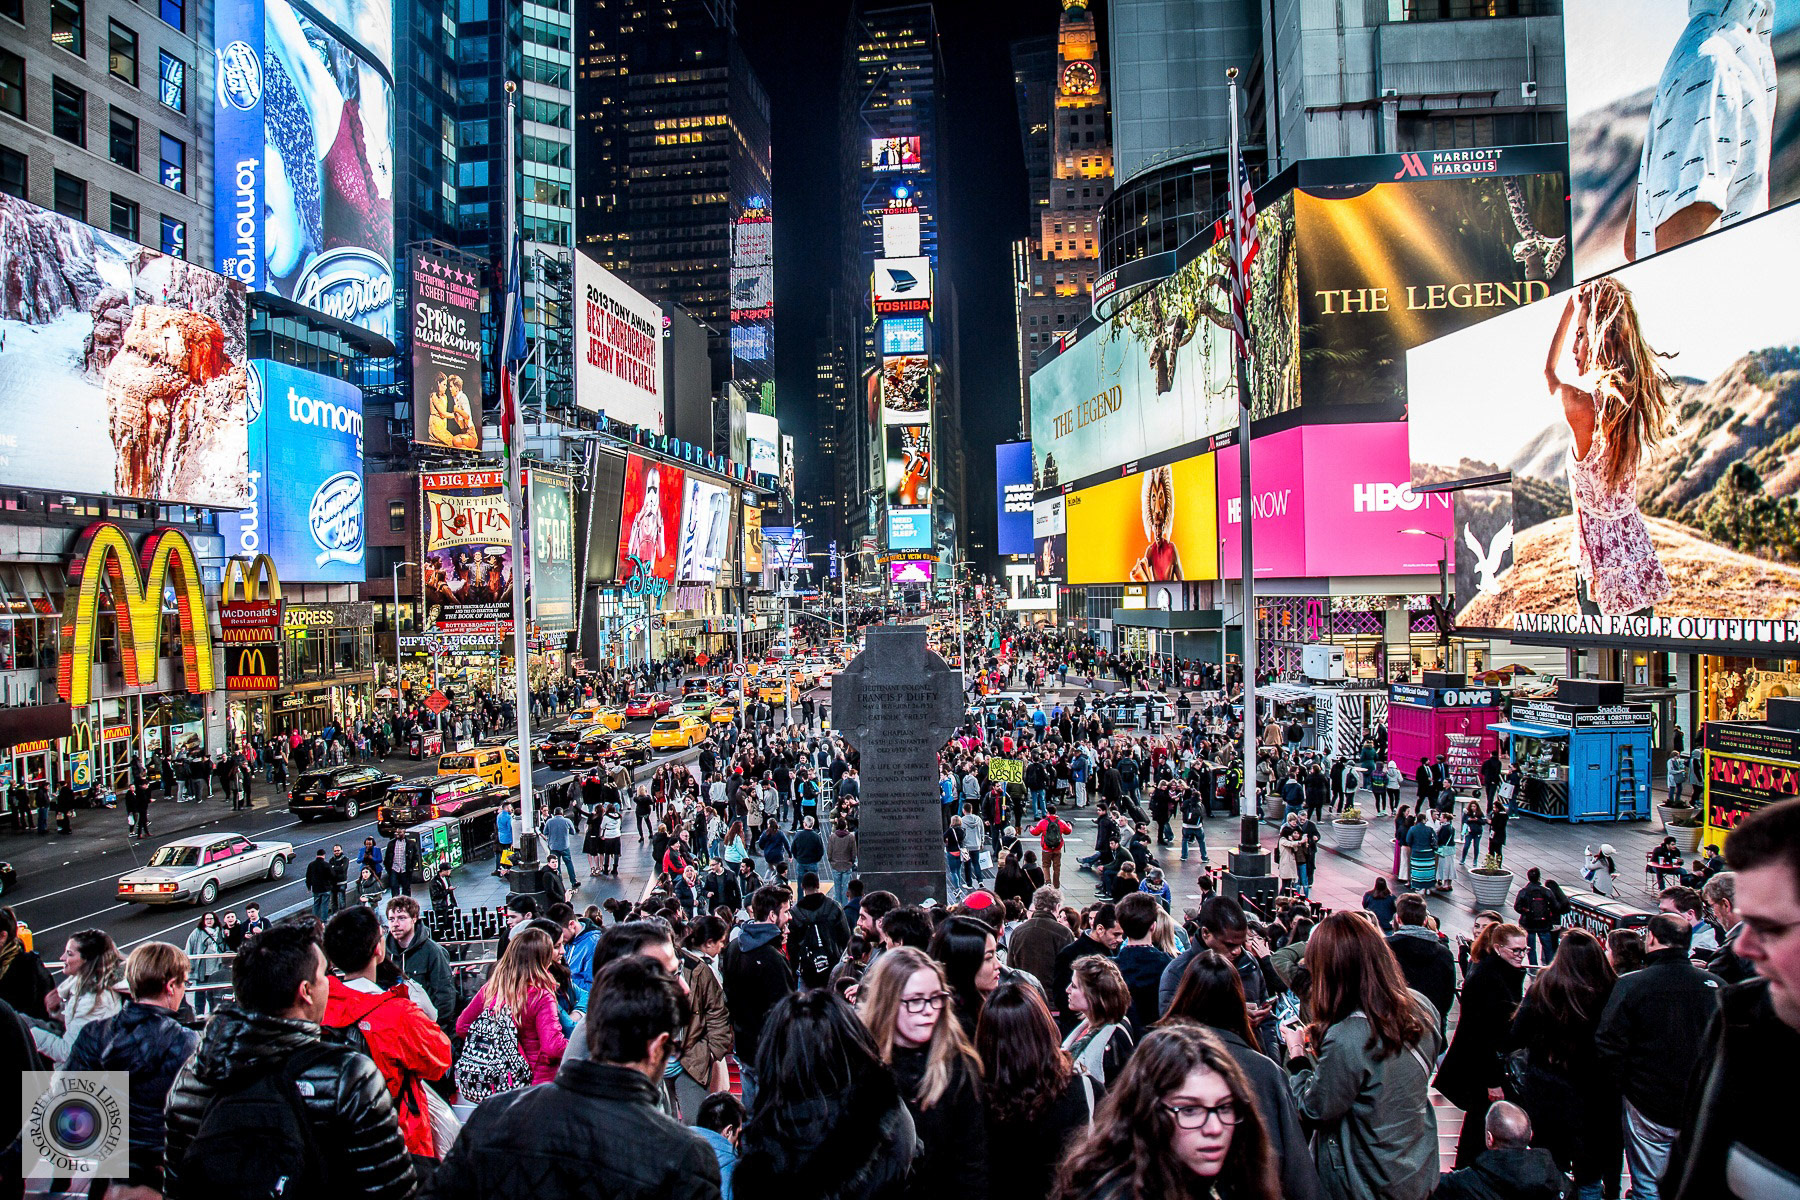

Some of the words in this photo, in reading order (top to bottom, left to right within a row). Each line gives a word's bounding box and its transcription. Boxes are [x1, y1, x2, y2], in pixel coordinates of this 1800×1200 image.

[1434, 150, 1502, 162] MARRIOTT
[1434, 162, 1496, 174] MARQUIS
[889, 199, 912, 208] 2016
[1095, 270, 1118, 290] MARRIOTT
[420, 283, 424, 296] A
[425, 285, 444, 302] SHEER
[1315, 288, 1390, 314] THE
[1406, 280, 1550, 311] LEGEND
[587, 284, 609, 310] 2013
[609, 298, 631, 324] TONY
[631, 312, 655, 339] AWARD
[876, 300, 929, 312] TOSHIBA
[416, 303, 466, 336] SPRING
[586, 300, 604, 340] BEST
[414, 326, 481, 361] awakening
[587, 336, 614, 373] JERRY
[616, 350, 657, 395] MITCHELL
[1053, 409, 1074, 440] THE
[1077, 384, 1123, 429] LEGEND
[635, 424, 680, 456] 1540
[1216, 431, 1232, 441] MARRIOTT
[468, 473, 487, 485] FAT
[1354, 482, 1424, 512] HBO
[537, 517, 568, 560] STAR
[626, 554, 668, 610] Disney
[221, 608, 278, 618] McDonald's
[284, 610, 334, 625] EXPRESS
[1515, 614, 1602, 635] AMERICAN
[1611, 616, 1672, 637] EAGLE
[1677, 617, 1800, 643] OUTFITTE
[399, 636, 433, 646] GIFTS
[283, 698, 304, 706] EXPRESS
[858, 694, 895, 702] FRANCIS
[907, 693, 938, 701] DUFFY
[1459, 691, 1492, 704] NYC
[1513, 707, 1534, 716] HOTDOGS
[1537, 711, 1556, 720] LOBSTER
[1528, 701, 1554, 712] SnackBox
